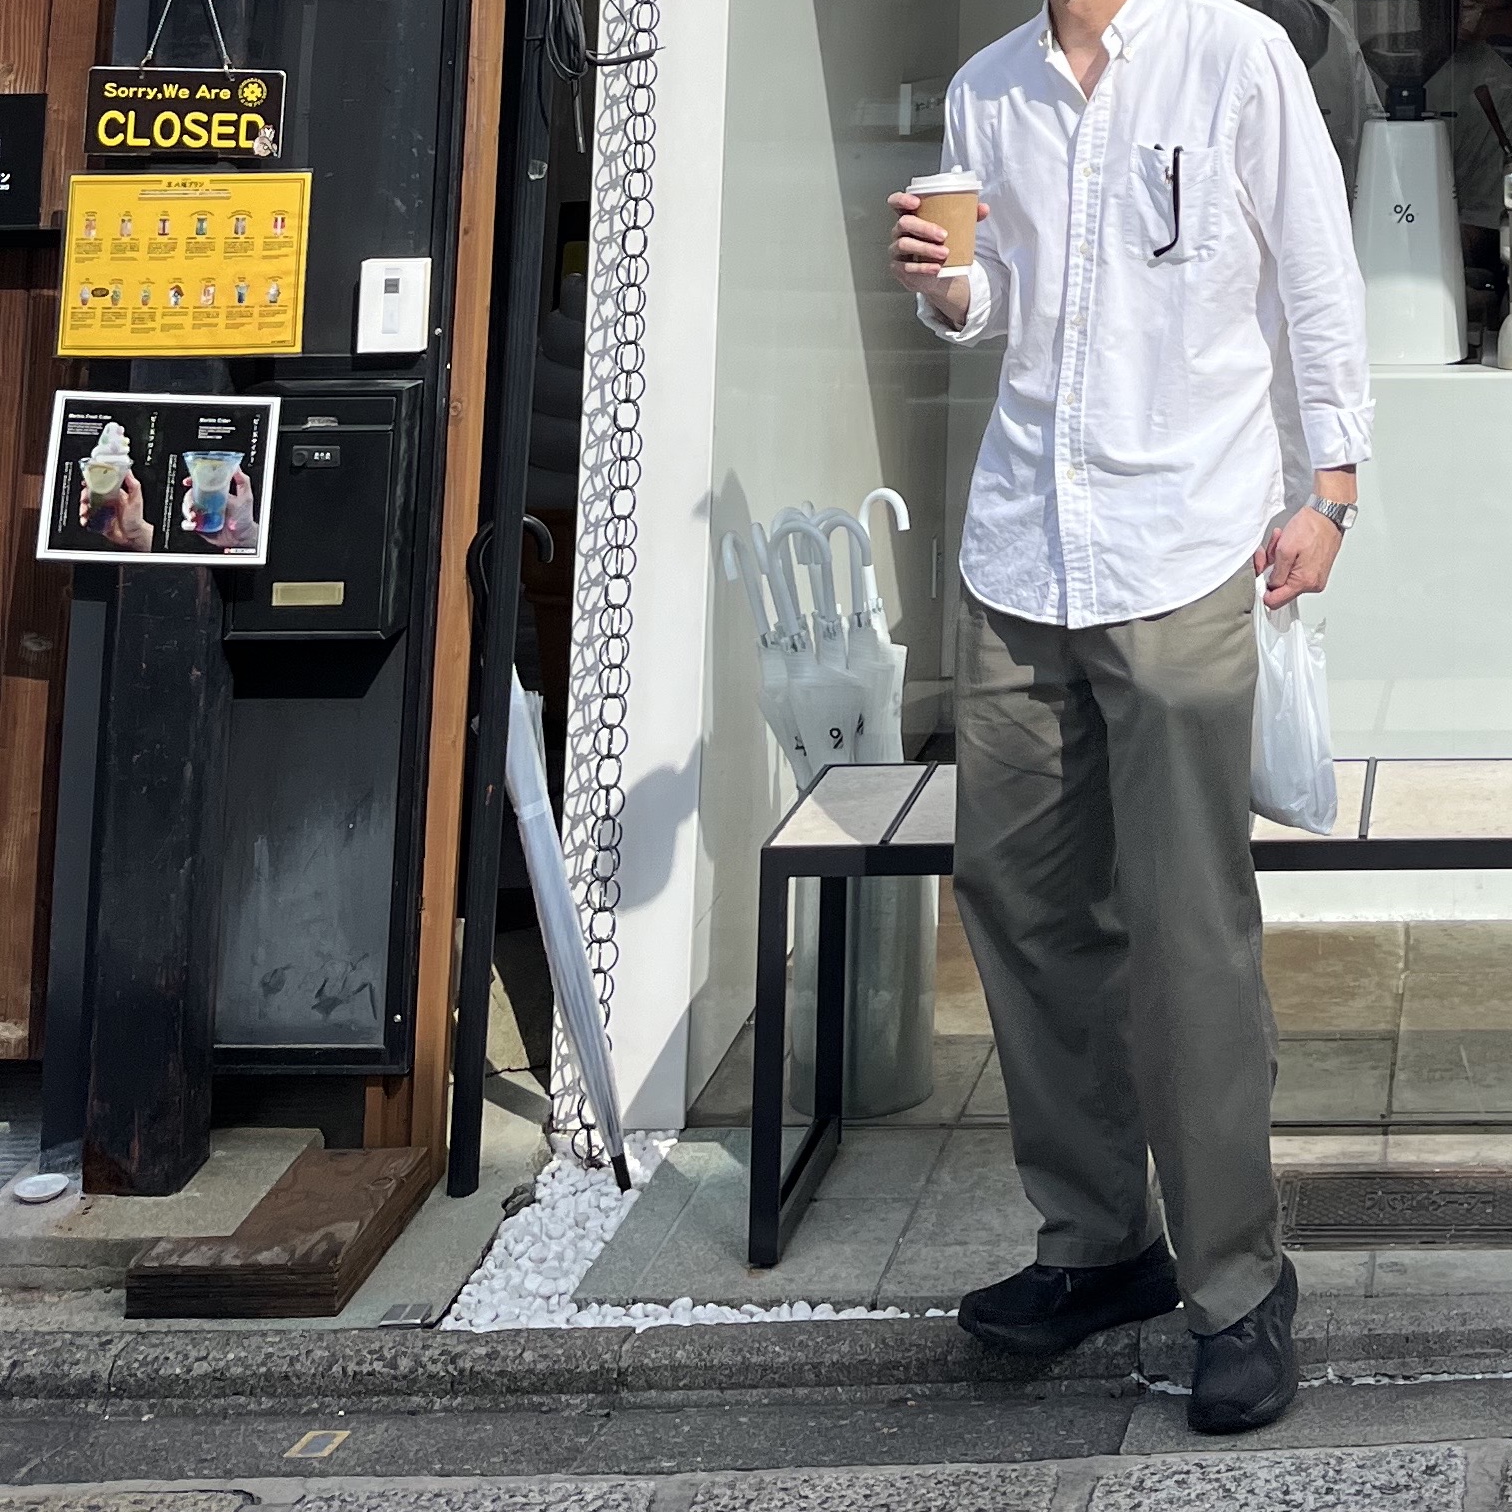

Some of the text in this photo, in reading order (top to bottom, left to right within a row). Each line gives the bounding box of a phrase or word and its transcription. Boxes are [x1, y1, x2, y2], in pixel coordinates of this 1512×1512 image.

[195, 85, 231, 100] Are
[97, 110, 265, 149] CLOSED
[1394, 204, 1415, 223] %
